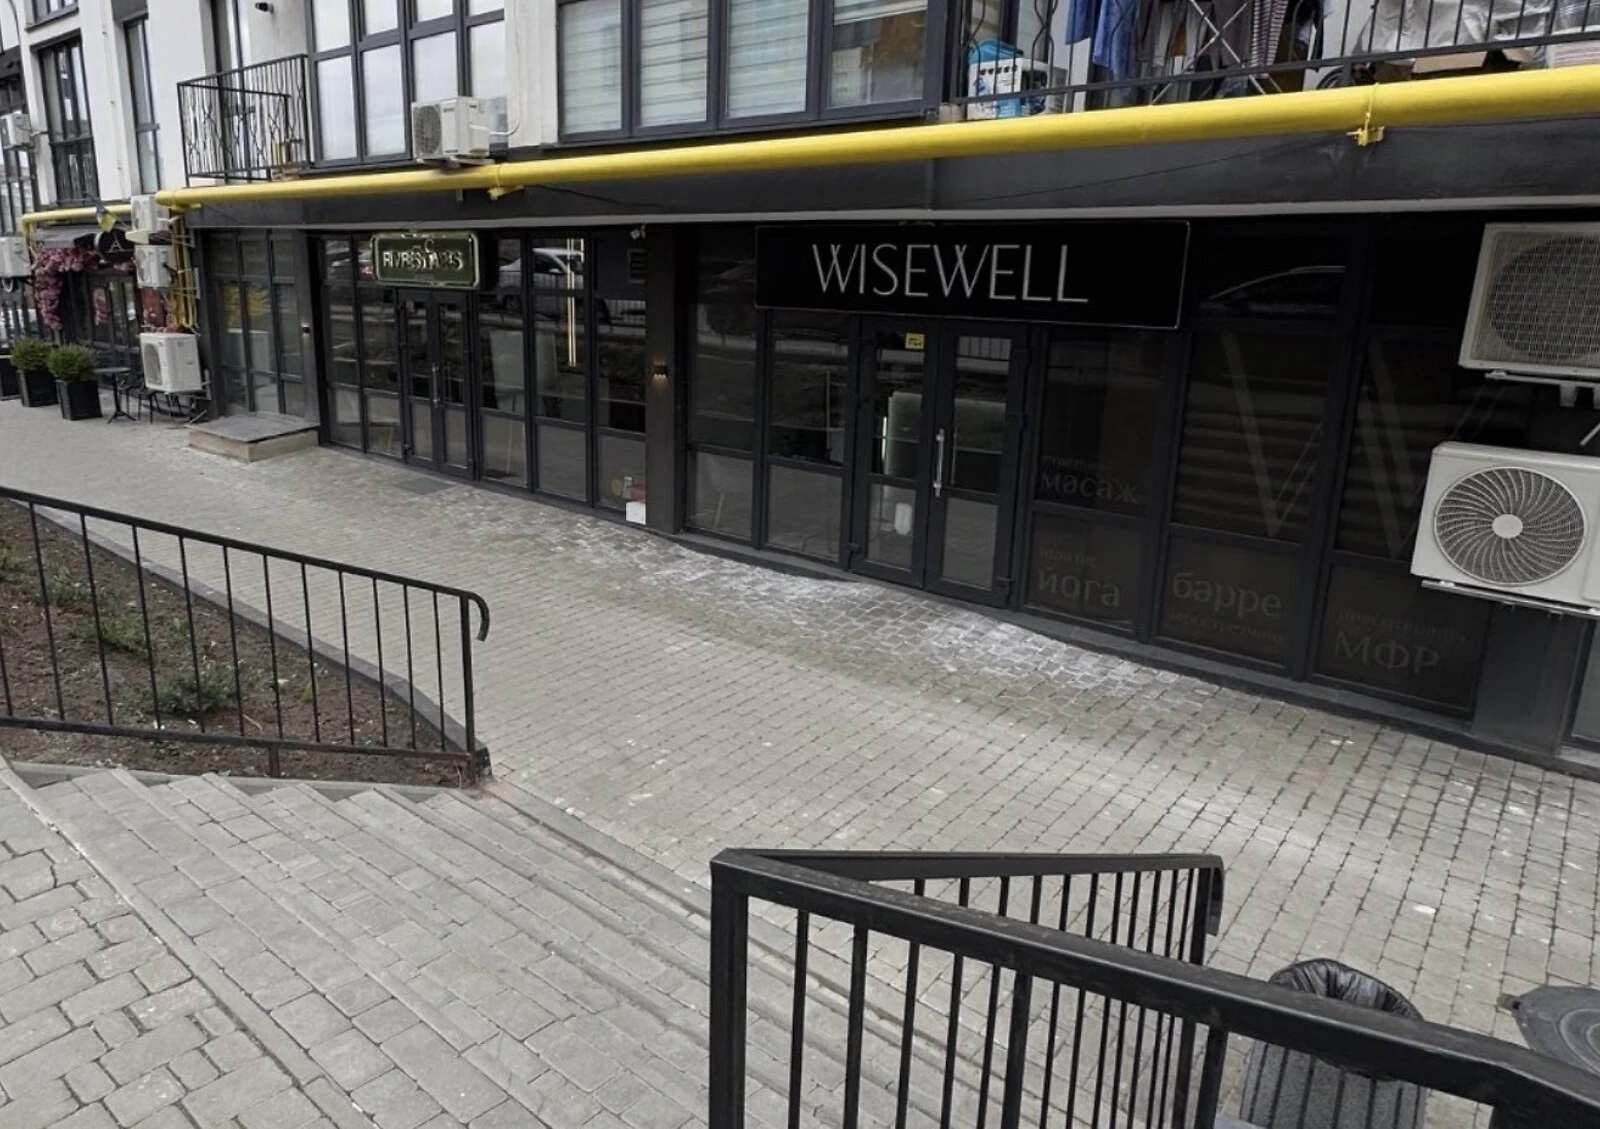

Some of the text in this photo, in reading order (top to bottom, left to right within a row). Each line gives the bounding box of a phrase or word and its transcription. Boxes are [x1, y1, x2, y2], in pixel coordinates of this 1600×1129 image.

[812, 243, 1089, 303] WISEWELL
[1040, 470, 1139, 505] масаж
[1038, 561, 1120, 608] йога
[1173, 571, 1282, 618] барре
[1333, 629, 1440, 675] МФР
